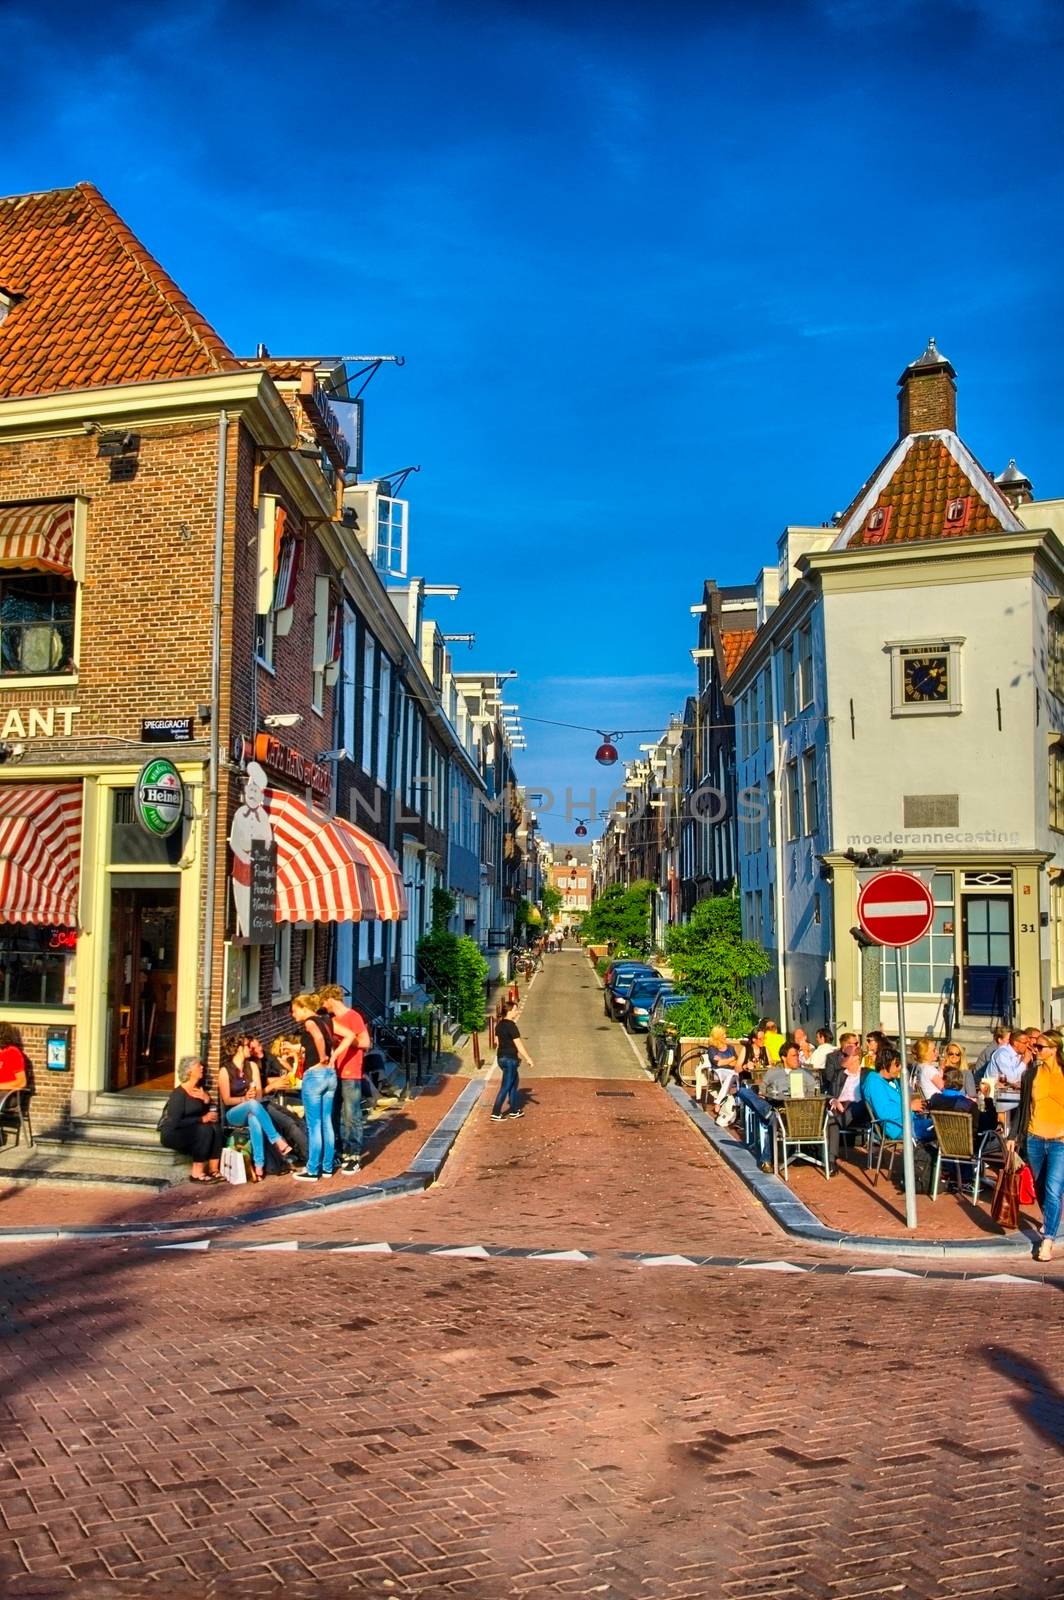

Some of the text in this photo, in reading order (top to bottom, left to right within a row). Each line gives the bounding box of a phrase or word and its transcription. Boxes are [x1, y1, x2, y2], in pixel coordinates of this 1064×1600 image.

[144, 719, 190, 730] SPIEGELGRACHT
[847, 829, 1021, 846] moederannecasting
[1020, 923, 1036, 933] 31
